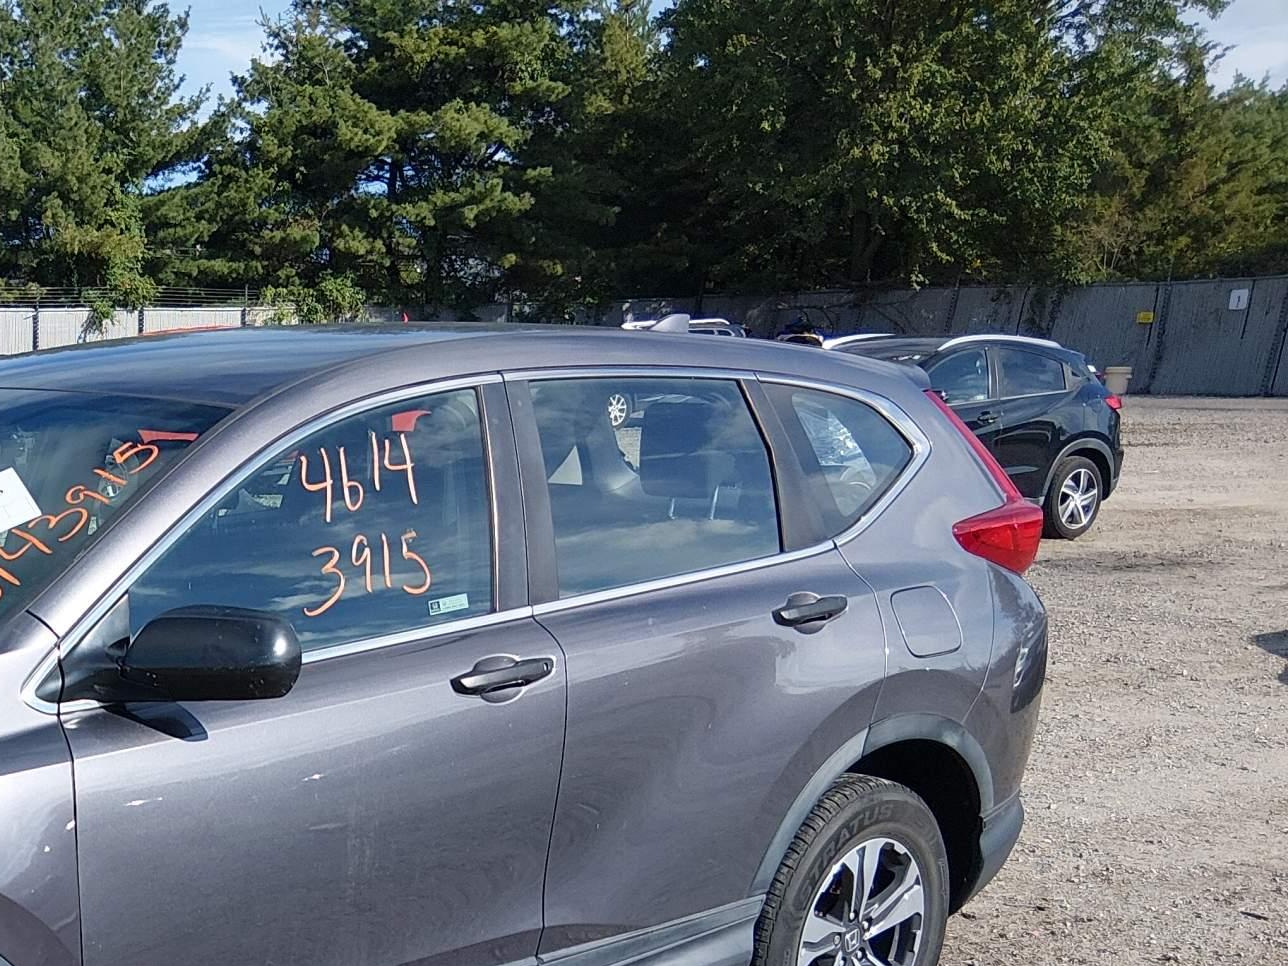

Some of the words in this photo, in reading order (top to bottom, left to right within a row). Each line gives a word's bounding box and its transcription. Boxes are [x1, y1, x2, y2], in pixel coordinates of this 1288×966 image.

[299, 430, 418, 523] 4614
[303, 528, 431, 617] 3915
[798, 804, 894, 902] STRATUS
